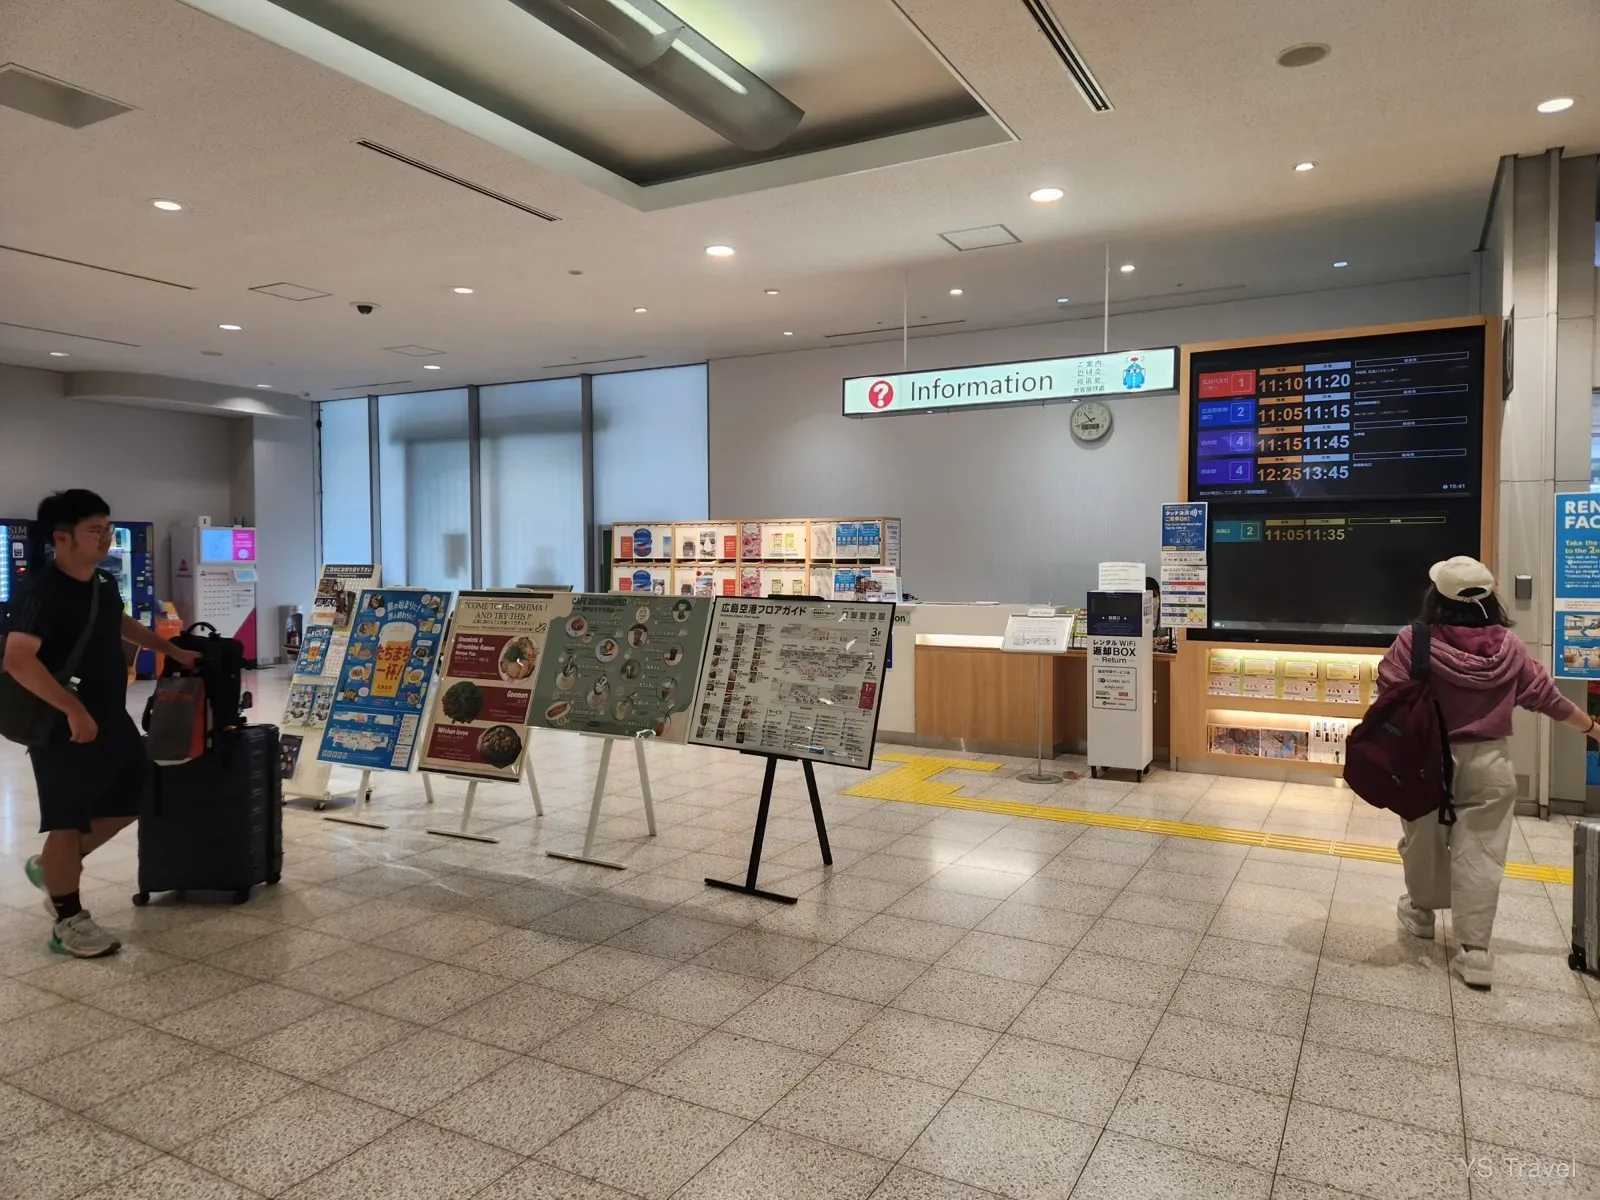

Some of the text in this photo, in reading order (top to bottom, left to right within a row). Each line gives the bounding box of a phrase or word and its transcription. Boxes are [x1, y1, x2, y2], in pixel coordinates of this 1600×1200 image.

[1077, 360, 1102, 368] ご案内
[1077, 368, 1102, 377] 안내소
[911, 371, 1054, 402] Information
[1238, 377, 1244, 388] 1
[1259, 377, 1303, 393] 11:10
[1304, 373, 1351, 390] 11:20
[1237, 406, 1245, 417] 2
[1258, 407, 1303, 422] 11:05
[1304, 404, 1350, 420] 11:15
[1236, 436, 1244, 447] 4
[1258, 437, 1302, 452] 11:15
[1303, 435, 1350, 450] 11:45
[1235, 465, 1243, 476] 4
[1257, 467, 1302, 482] 12:25
[1303, 465, 1350, 480] 13:45
[1565, 515, 1600, 529] FAC
[8, 526, 27, 534] SIM
[1246, 526, 1254, 536] 2
[1265, 529, 1304, 541] 11:05
[1305, 528, 1345, 541] 11:35
[501, 603, 543, 611] HIROSHIMA
[721, 603, 807, 616] 広島空港フロアガイド
[871, 627, 881, 637] 3F
[374, 644, 413, 662] たちまち
[1093, 646, 1136, 656] 返却BOX
[376, 662, 403, 680] 一杯!
[866, 661, 876, 672] 2F
[865, 683, 872, 693] 1F
[506, 690, 528, 699] Goemon
